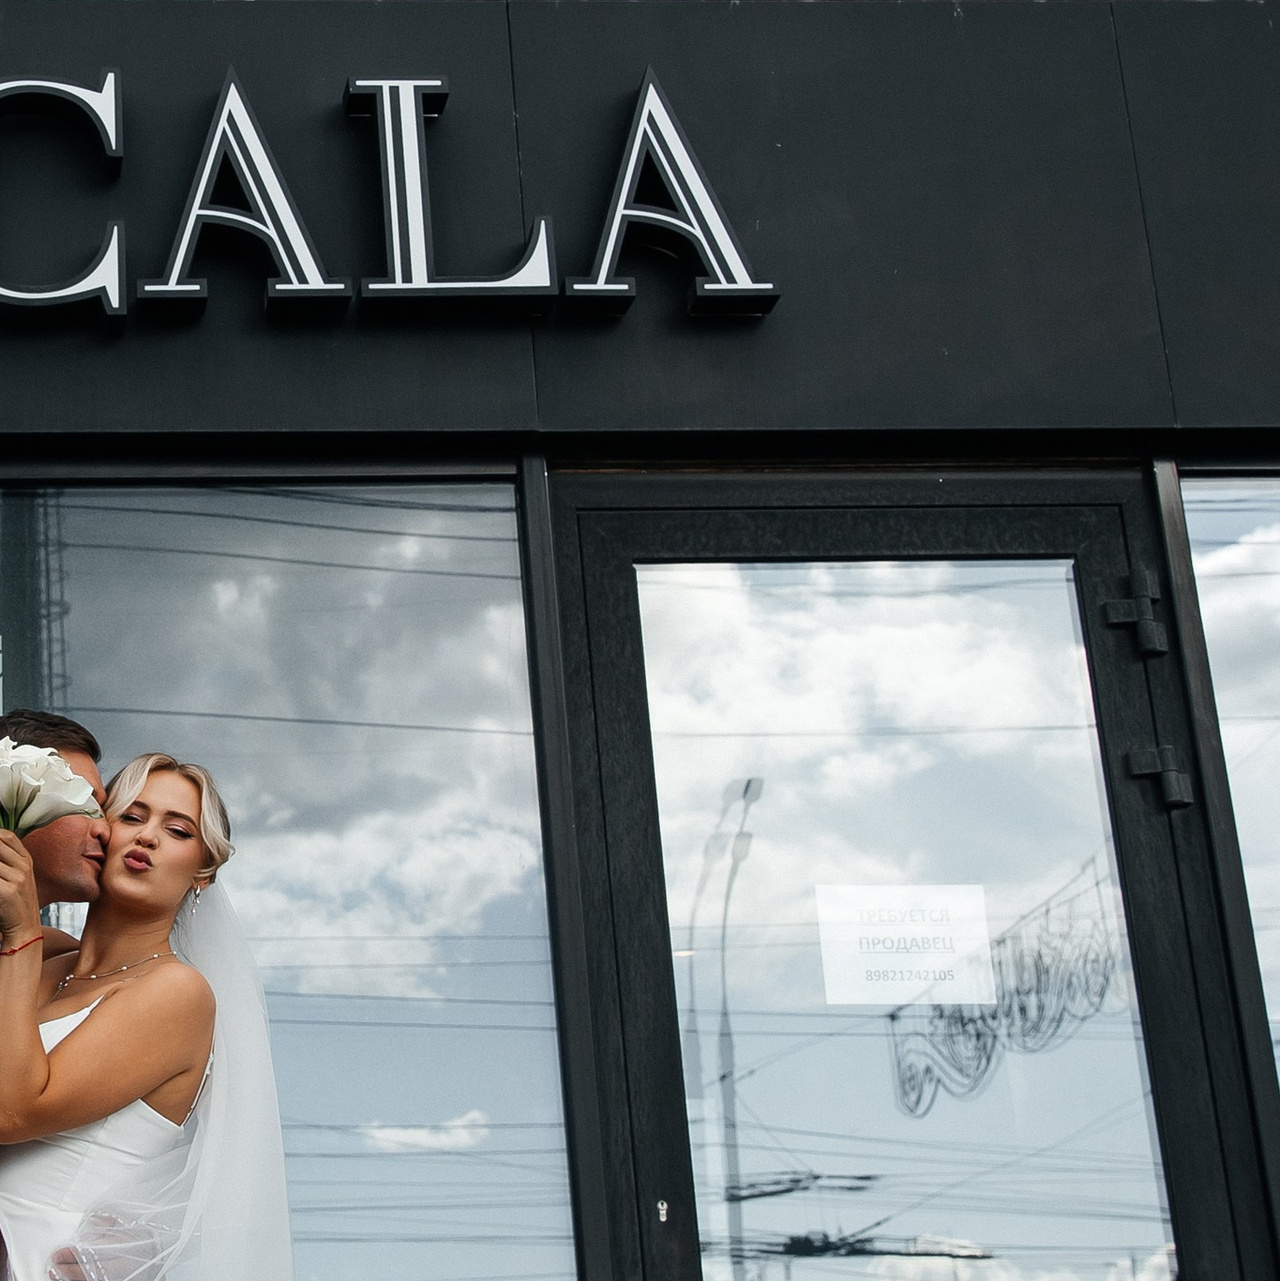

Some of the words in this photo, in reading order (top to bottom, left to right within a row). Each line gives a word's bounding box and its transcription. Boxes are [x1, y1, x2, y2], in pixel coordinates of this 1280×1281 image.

[856, 908, 950, 923] ТРЕБУЕТСЯ
[859, 936, 956, 953] ПРОДАВЕЦ
[865, 969, 955, 982] 89821242105
